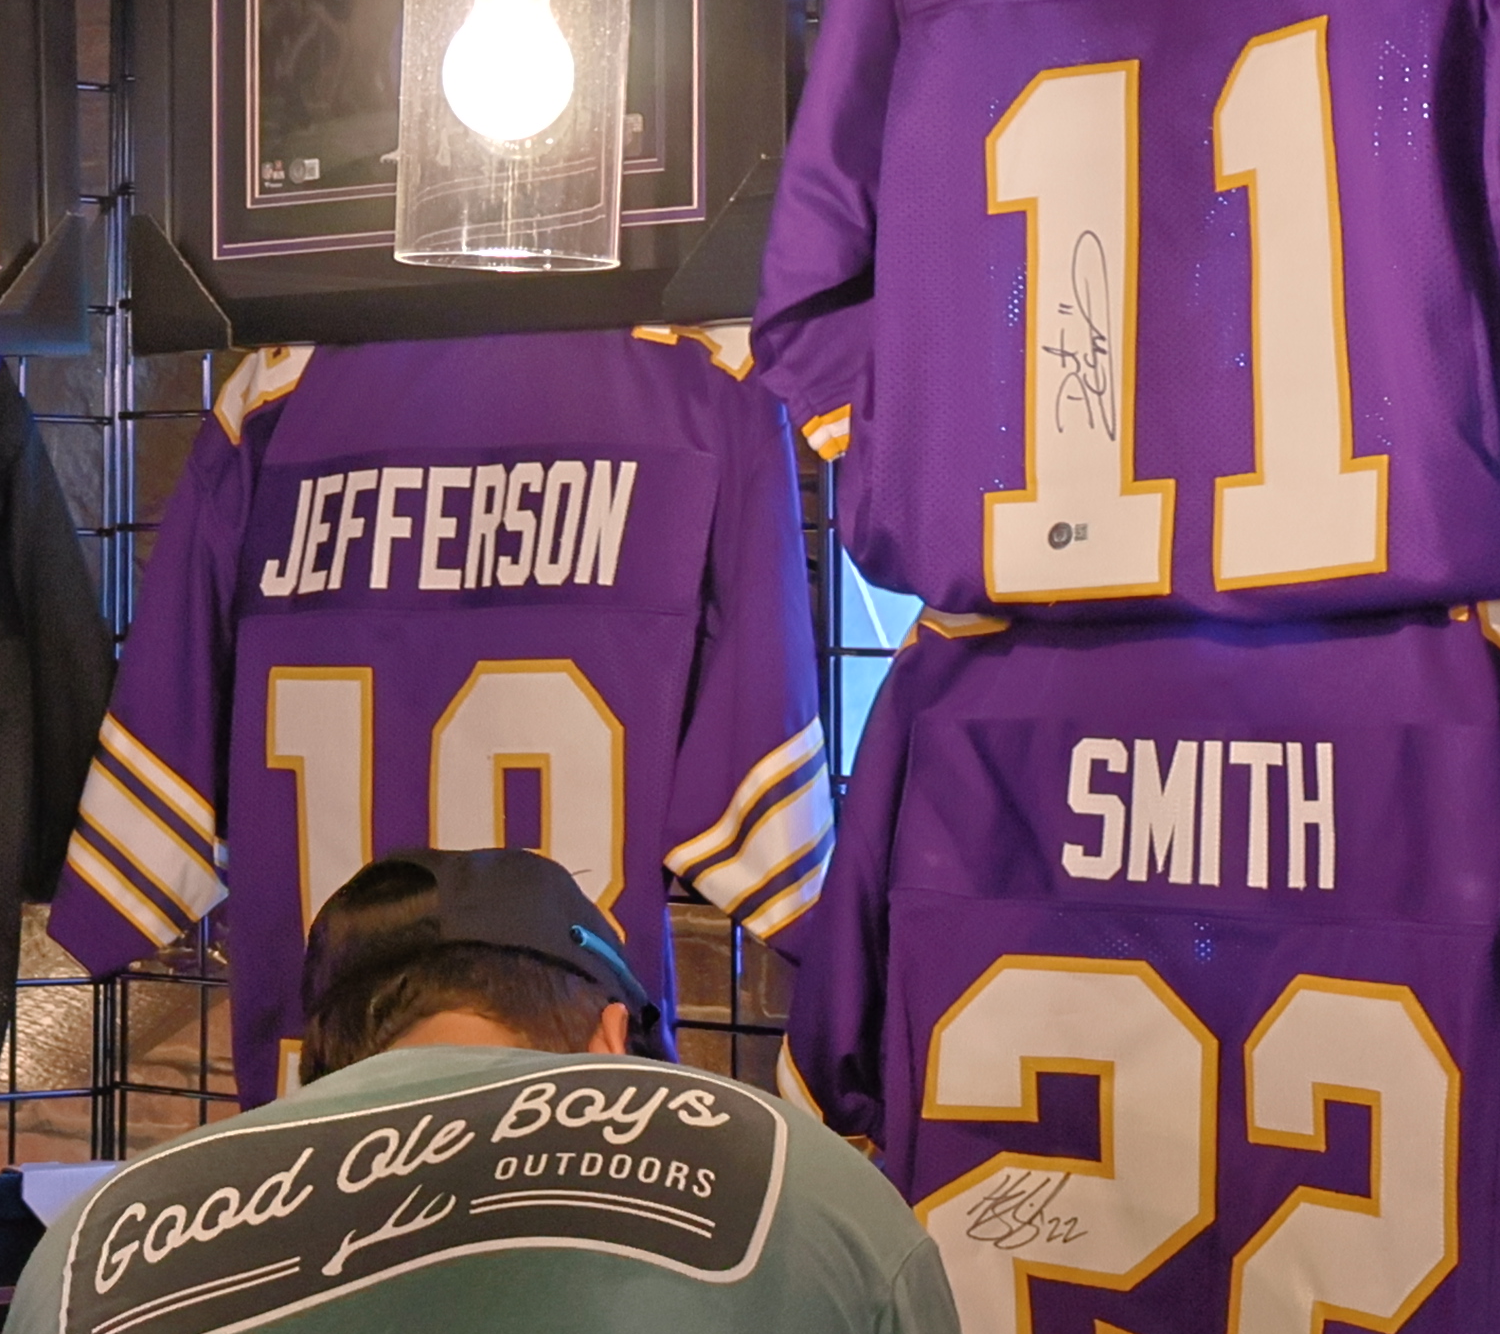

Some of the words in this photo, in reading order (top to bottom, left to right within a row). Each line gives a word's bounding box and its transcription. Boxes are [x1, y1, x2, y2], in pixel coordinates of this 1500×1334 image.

[983, 14, 1389, 605] 11
[260, 460, 638, 597] JEFFERSON
[1061, 737, 1337, 891] SMITH
[94, 1146, 316, 1295] Good
[336, 1113, 476, 1195] Ole
[490, 1081, 731, 1145] Boys
[494, 1151, 717, 1199] OUTDOORS
